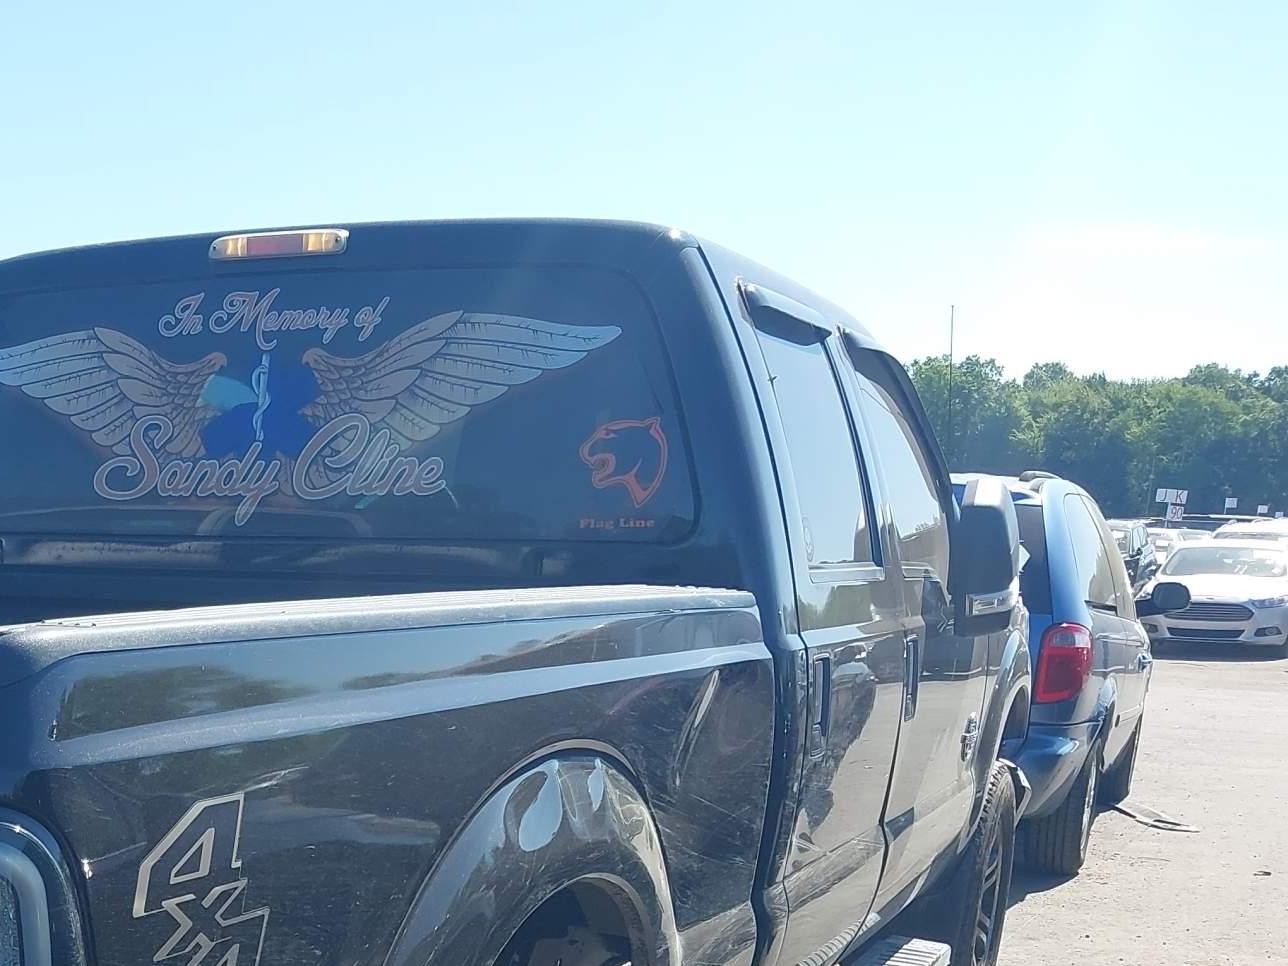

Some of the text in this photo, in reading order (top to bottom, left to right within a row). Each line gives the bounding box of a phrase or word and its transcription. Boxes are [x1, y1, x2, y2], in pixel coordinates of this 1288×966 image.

[159, 288, 390, 350] In Memory of
[94, 413, 446, 526] Sandy Cline
[1175, 490, 1185, 502] K
[1171, 507, 1182, 519] 90
[618, 518, 655, 528] Line
